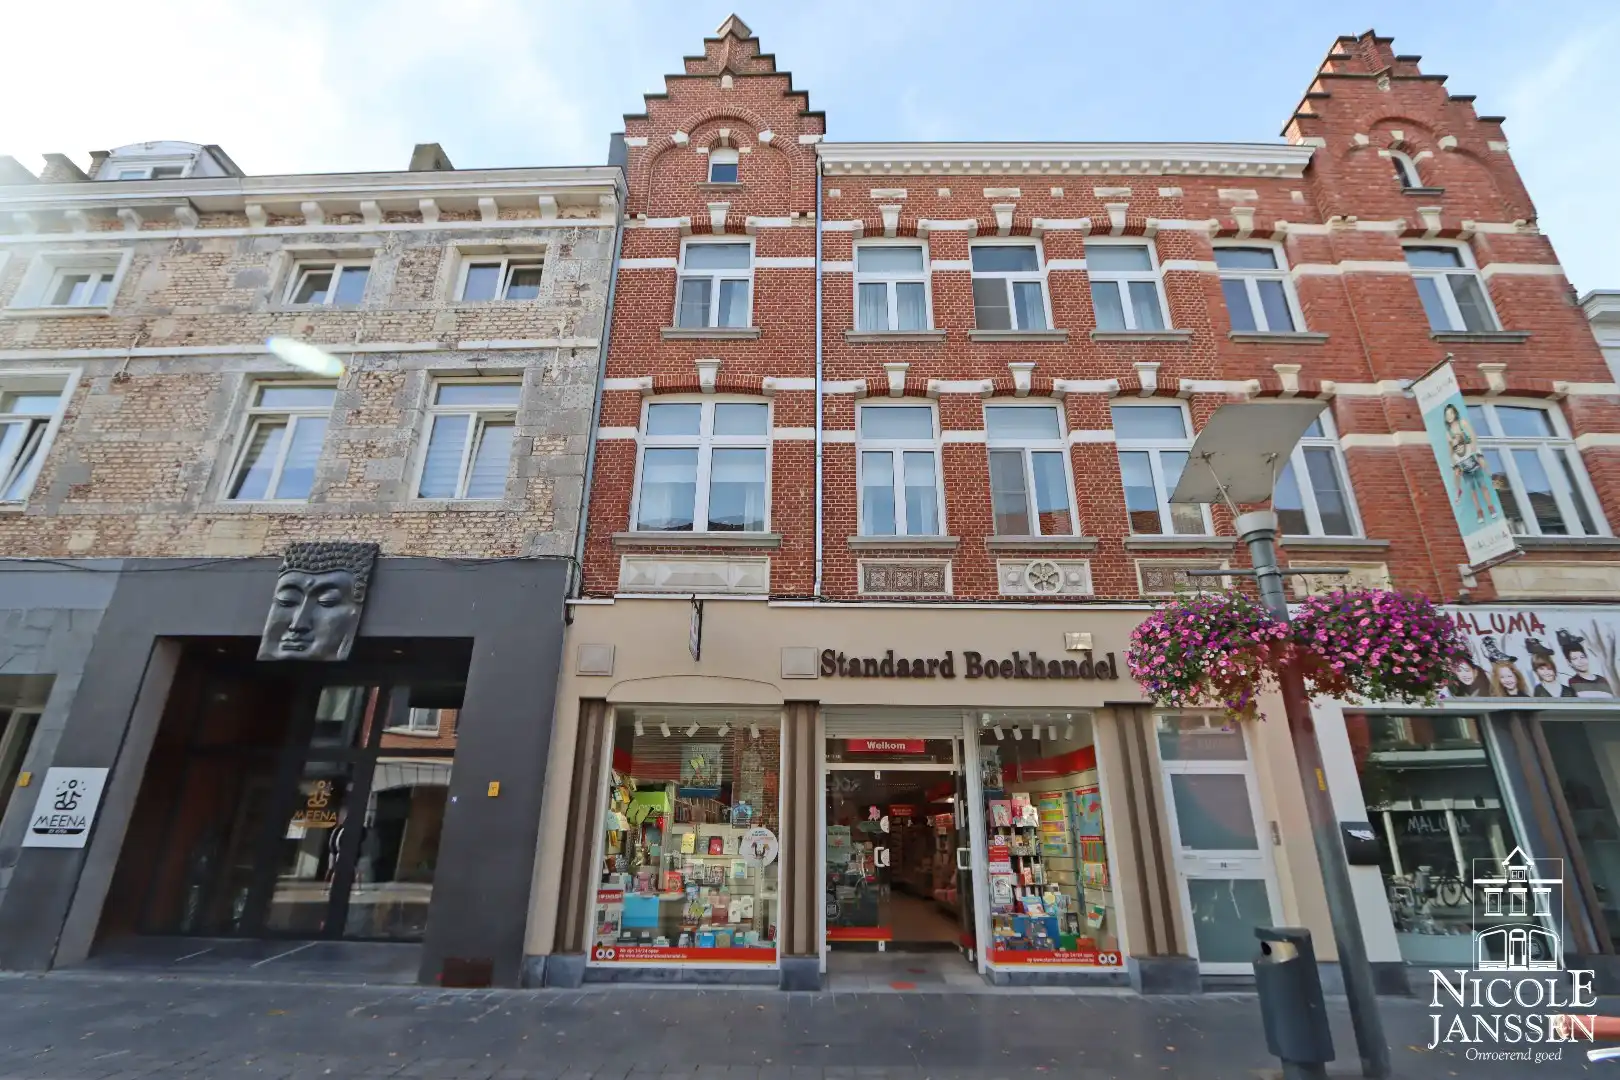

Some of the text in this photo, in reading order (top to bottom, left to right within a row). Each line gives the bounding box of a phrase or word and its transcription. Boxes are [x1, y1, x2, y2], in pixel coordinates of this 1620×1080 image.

[1443, 611, 1546, 636] ALUMA
[820, 649, 1119, 680] Standaard Boekhandel
[867, 741, 906, 750] Welkom
[33, 815, 86, 827] MEENA
[292, 810, 337, 821] MEENA
